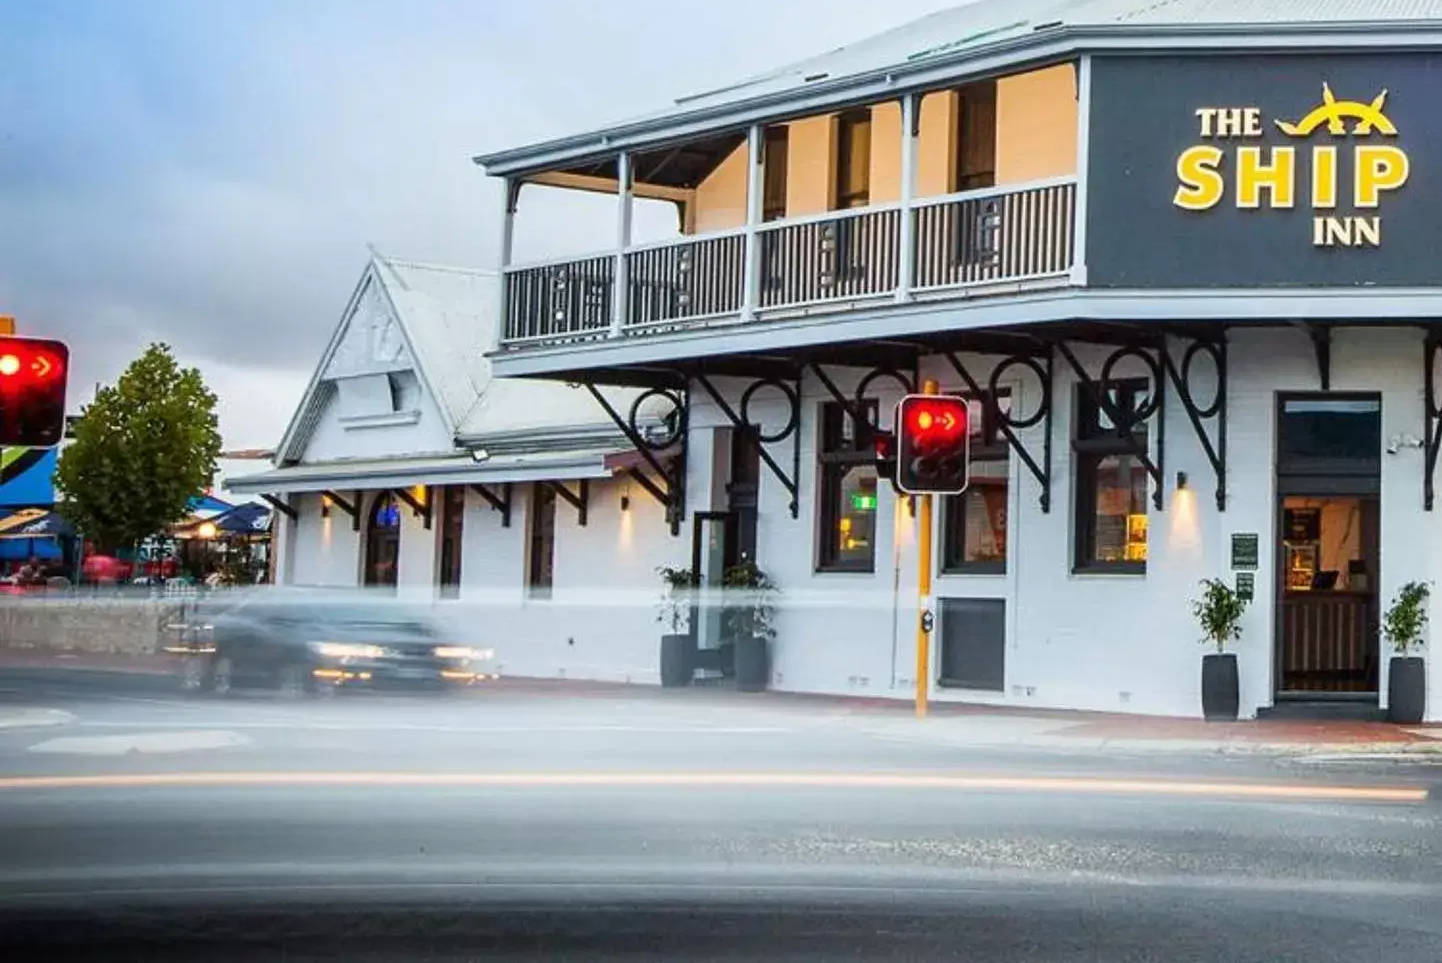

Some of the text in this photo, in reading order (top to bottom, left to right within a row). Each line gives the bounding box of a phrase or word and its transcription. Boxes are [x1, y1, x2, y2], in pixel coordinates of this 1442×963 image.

[1195, 108, 1263, 136] THE
[1173, 145, 1410, 210] SHIP
[1312, 216, 1381, 246] INN
